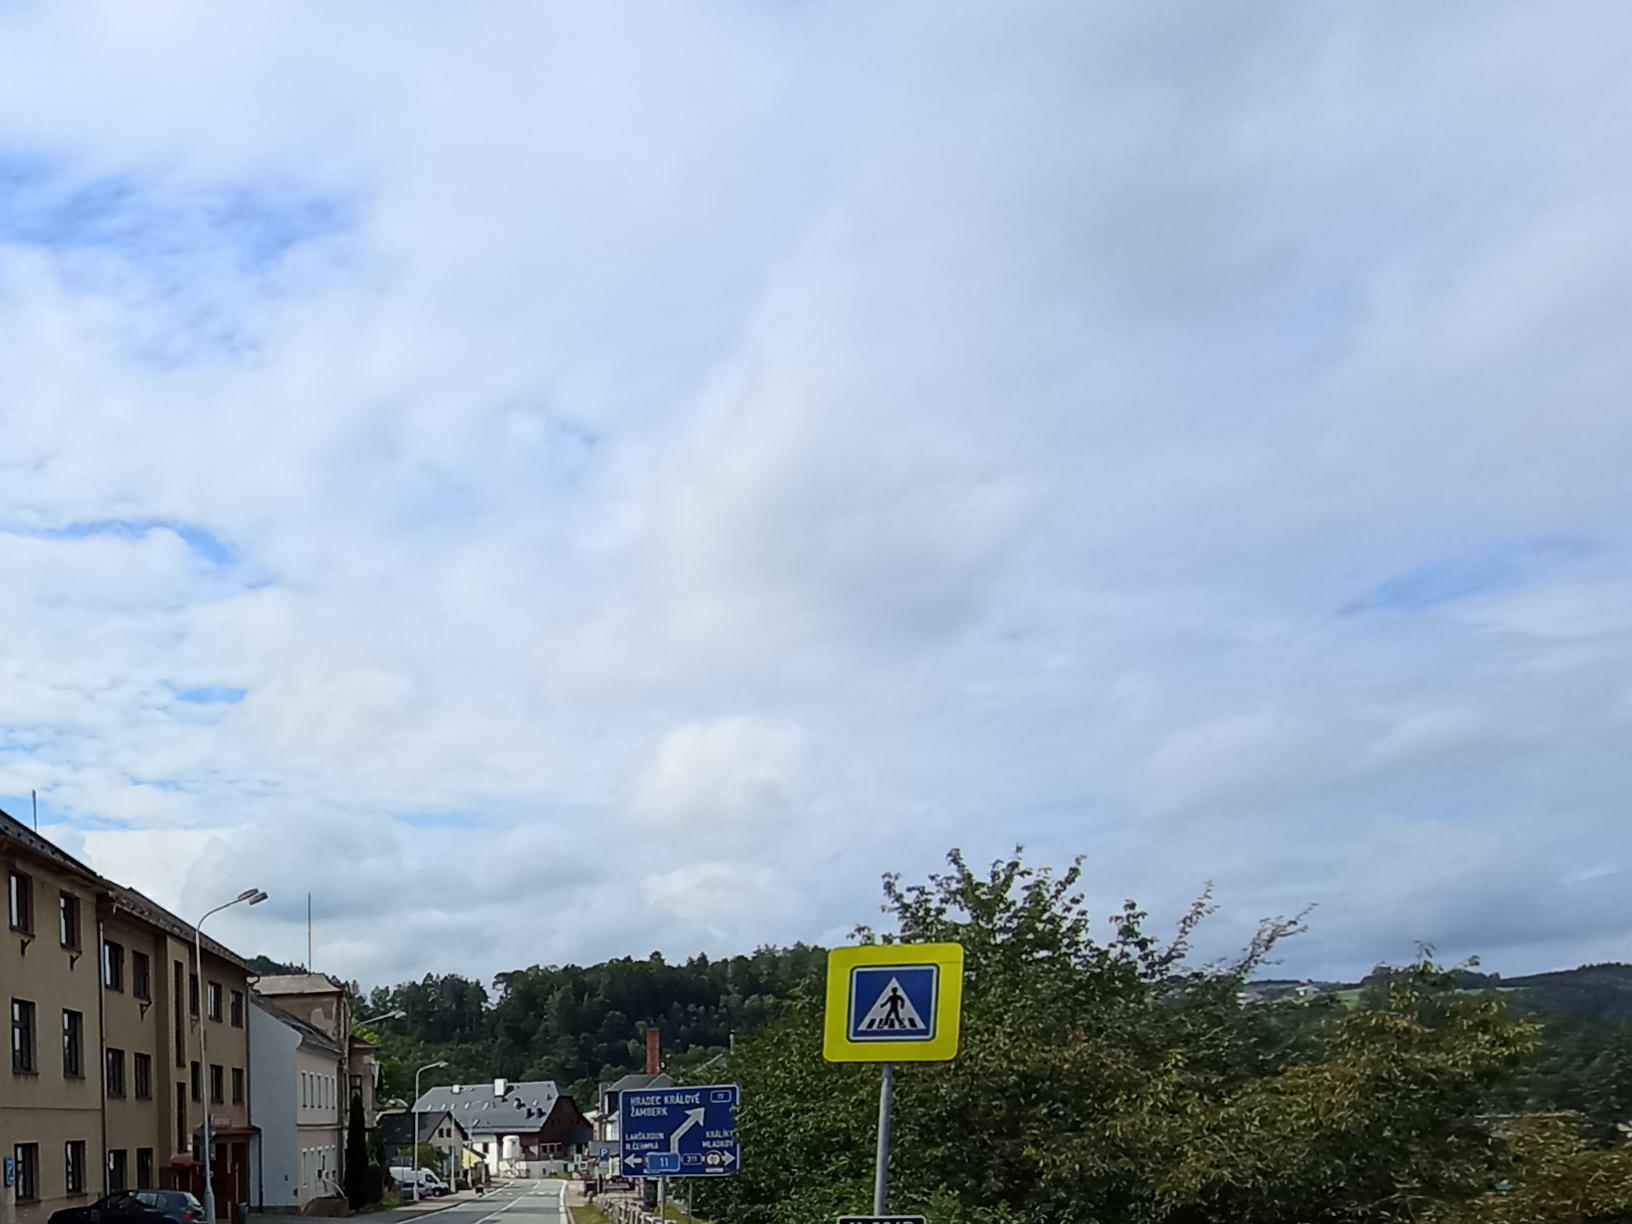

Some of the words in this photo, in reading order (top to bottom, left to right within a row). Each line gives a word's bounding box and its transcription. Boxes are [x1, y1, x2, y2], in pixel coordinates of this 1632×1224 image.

[630, 1095, 662, 1106] HRADEC
[664, 1092, 701, 1105] KRÁLOVÉ
[630, 1105, 668, 1117] ŽAMBERK
[601, 1148, 609, 1157] P
[659, 1157, 669, 1167] 11
